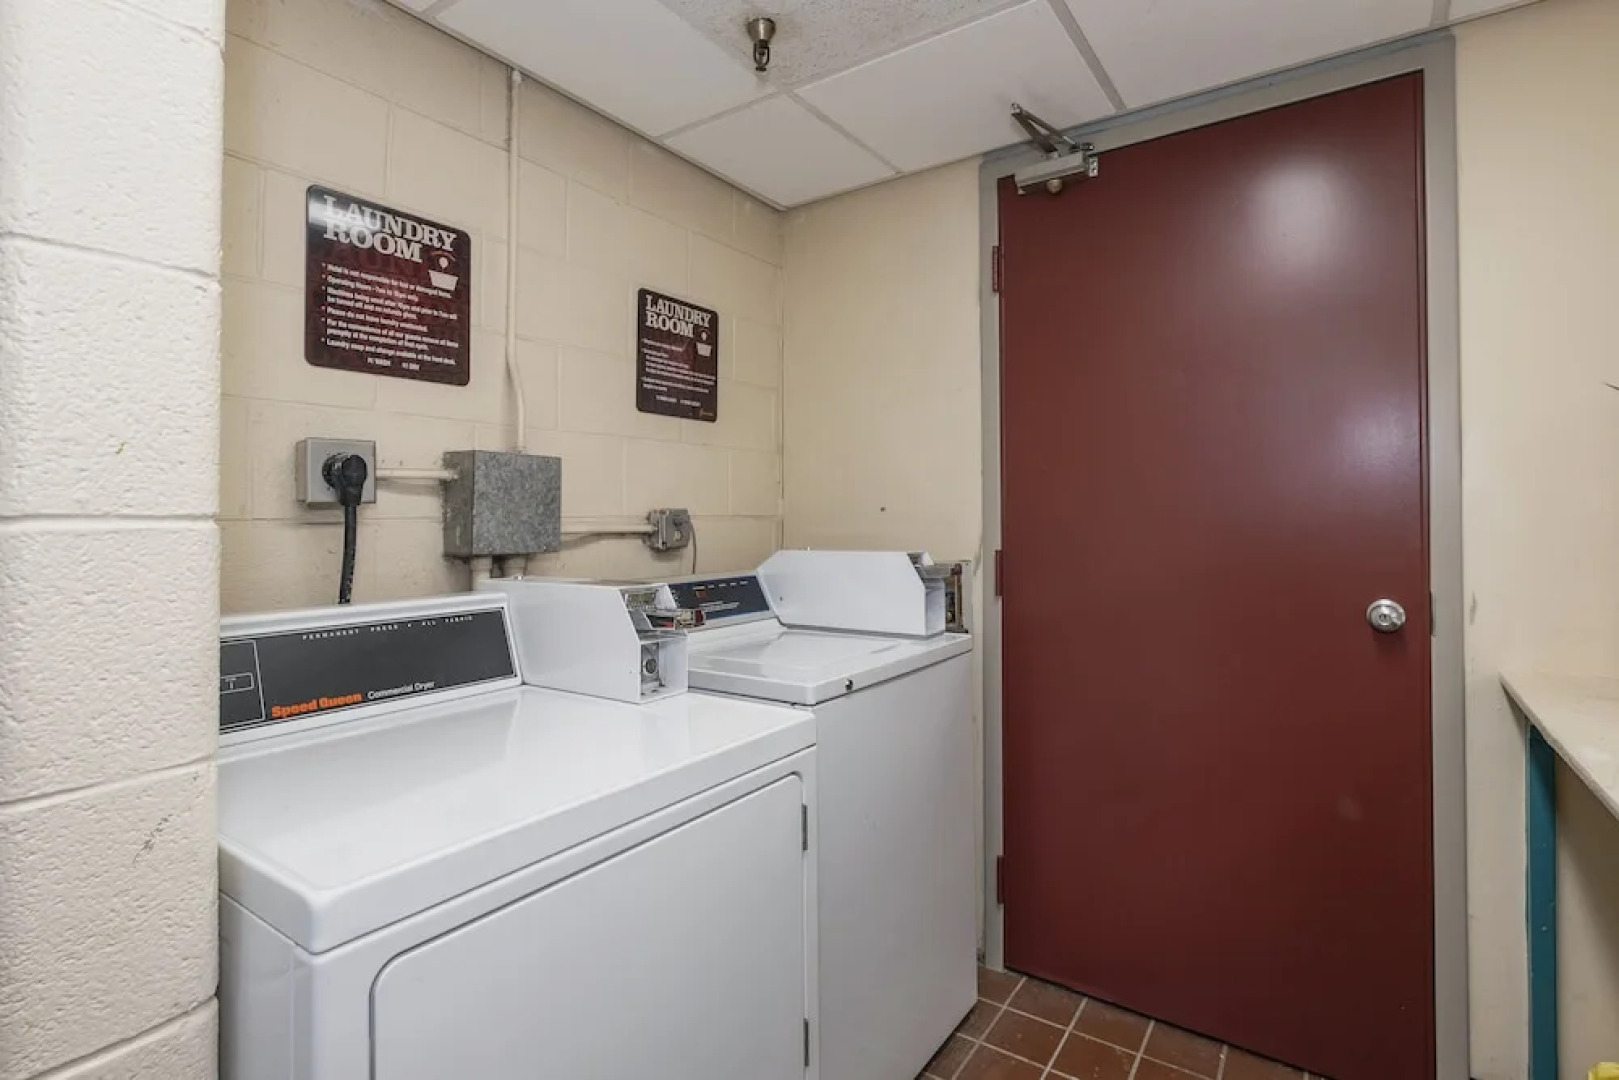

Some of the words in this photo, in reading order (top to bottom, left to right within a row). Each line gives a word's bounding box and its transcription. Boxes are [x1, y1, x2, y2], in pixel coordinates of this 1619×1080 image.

[323, 195, 457, 251] LAUNDRY
[323, 218, 423, 263] ROOM
[646, 294, 711, 328] LAUNDRY
[646, 311, 694, 338] ROOM
[302, 628, 359, 640] PERMANENT
[370, 624, 398, 632] PRESS
[271, 699, 318, 718] Speed
[319, 693, 363, 708] Queen
[367, 685, 414, 700] Commercial
[414, 681, 435, 692] Dryer
